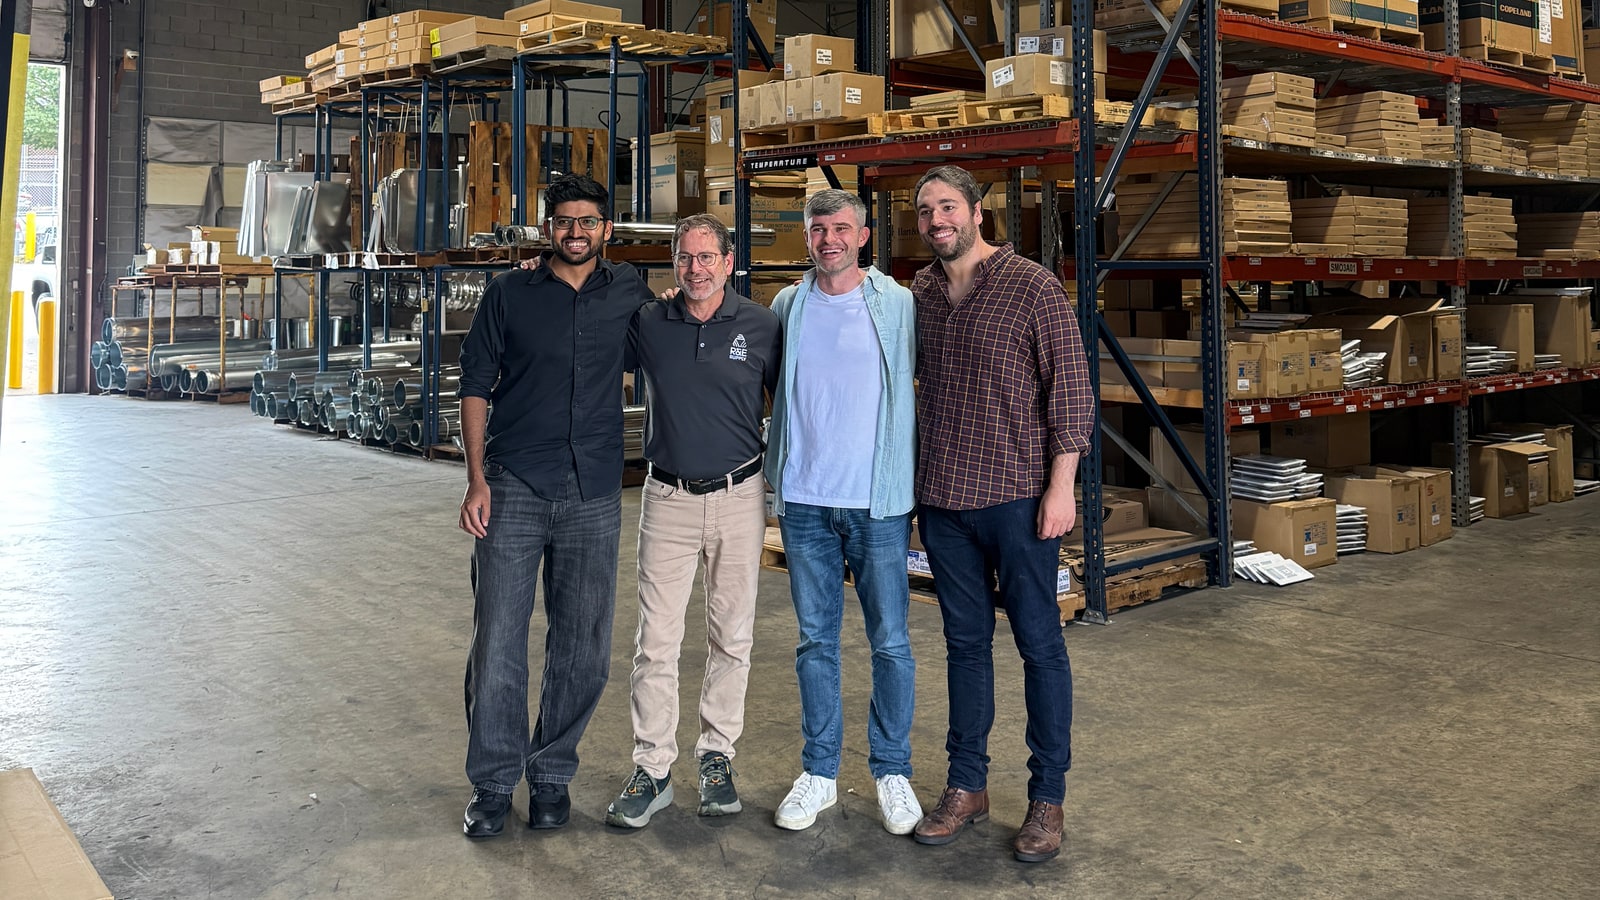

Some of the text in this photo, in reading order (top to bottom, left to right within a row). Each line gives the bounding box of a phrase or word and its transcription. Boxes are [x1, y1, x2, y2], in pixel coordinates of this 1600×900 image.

[1500, 4, 1531, 18] COPELAND
[751, 158, 808, 169] TEMPERATURE
[730, 347, 748, 357] R&E
